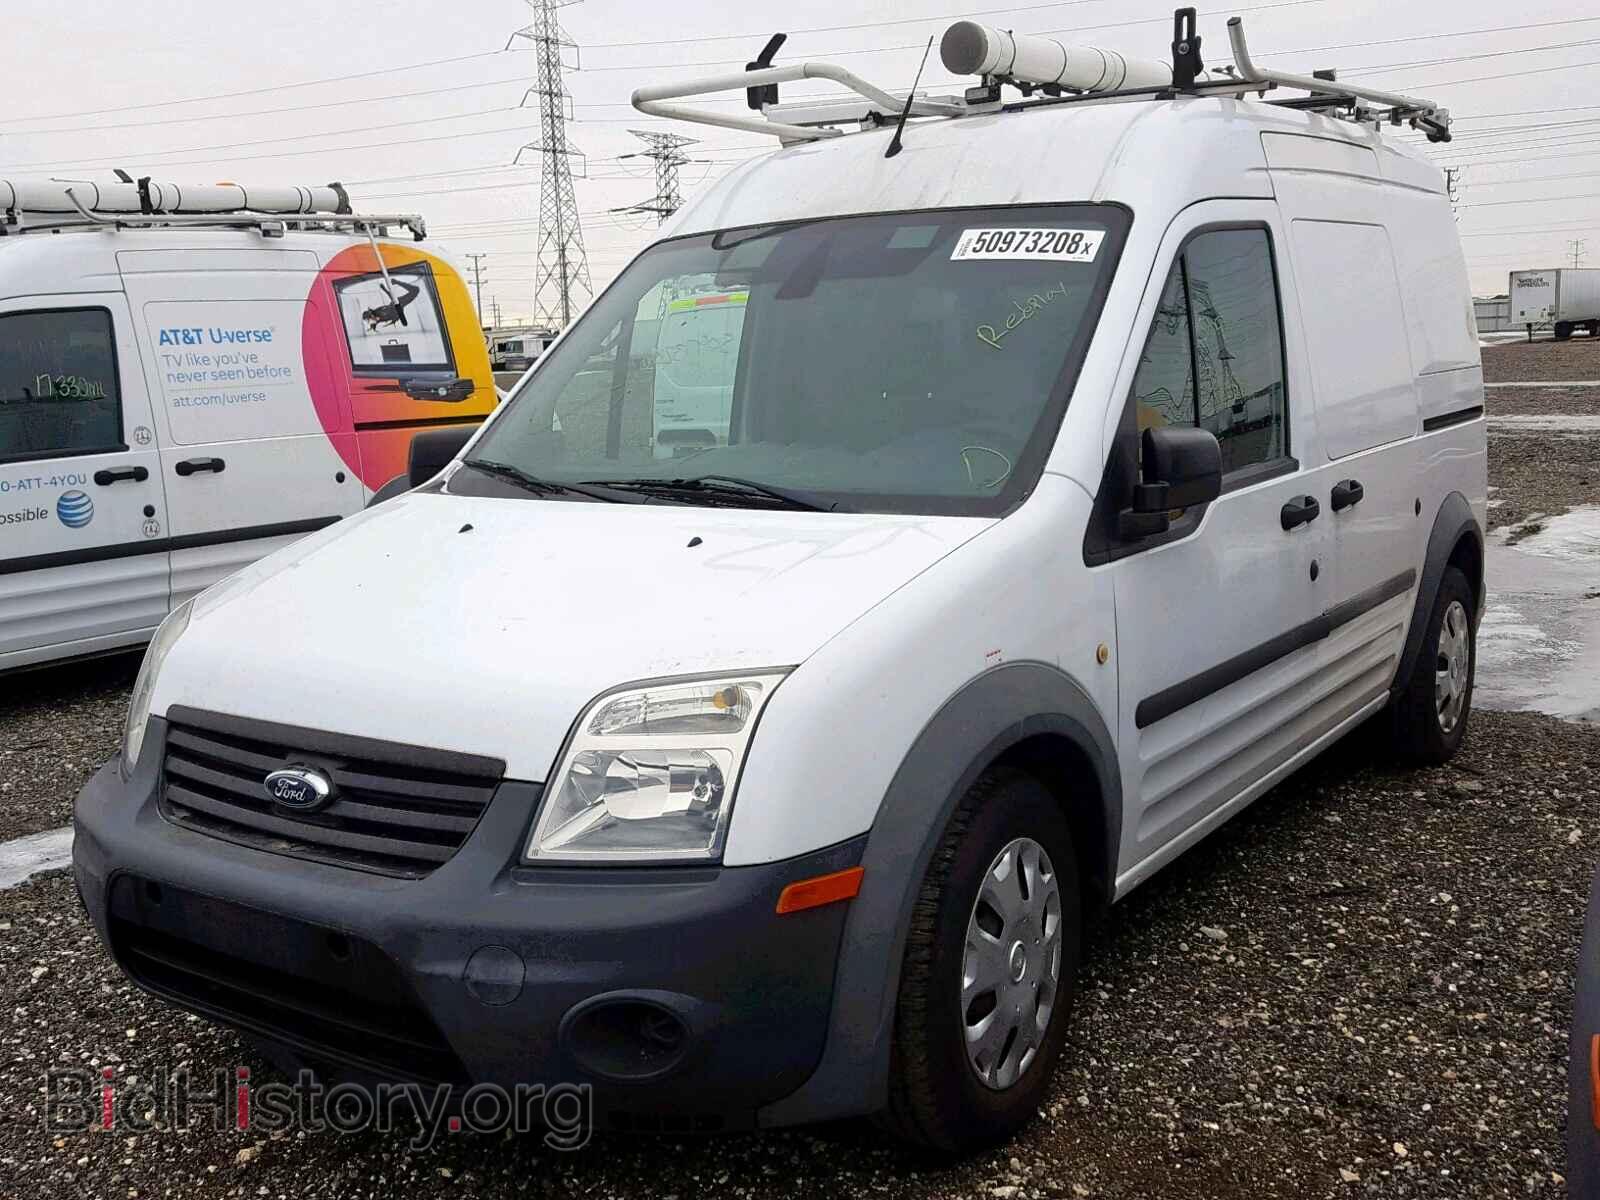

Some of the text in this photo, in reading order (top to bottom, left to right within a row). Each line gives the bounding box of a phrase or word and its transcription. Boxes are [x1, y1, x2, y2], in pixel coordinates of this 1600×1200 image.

[159, 327, 272, 346] AT&T U-verse
[161, 352, 258, 368] TV like you've
[167, 365, 292, 383] never seen before
[173, 391, 267, 408] att.com/uverse
[274, 777, 307, 801] Ford
